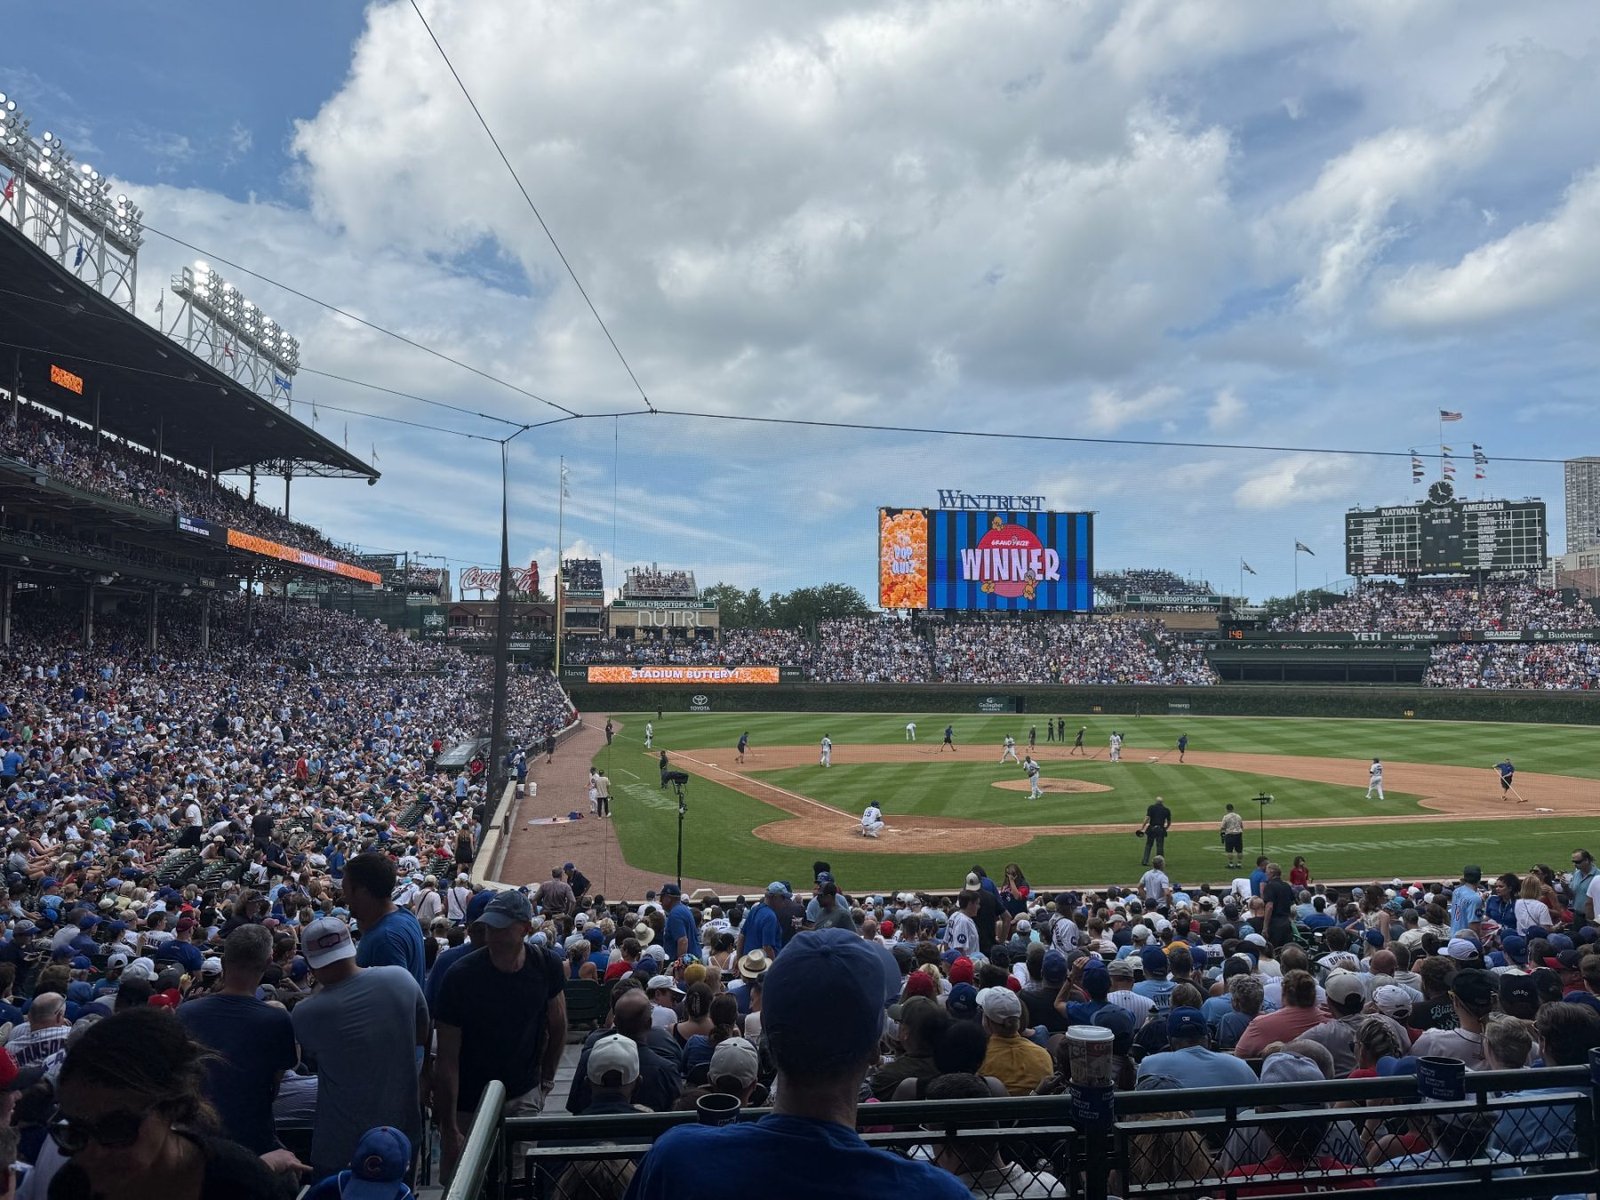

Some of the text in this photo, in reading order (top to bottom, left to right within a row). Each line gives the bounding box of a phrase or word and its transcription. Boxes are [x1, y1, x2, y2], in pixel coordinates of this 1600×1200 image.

[937, 489, 1046, 511] WINTRUST
[1381, 507, 1421, 517] NATIONAL
[1462, 502, 1504, 512] AMERICAN
[893, 544, 913, 560] POP
[892, 559, 916, 574] QUIZ
[960, 548, 1061, 582] WINNER
[1352, 632, 1381, 641] YETI
[1397, 632, 1439, 641] tastytrade
[1548, 631, 1591, 640] Budweiser
[564, 669, 587, 679] Harvey
[631, 668, 683, 679] STADIUM
